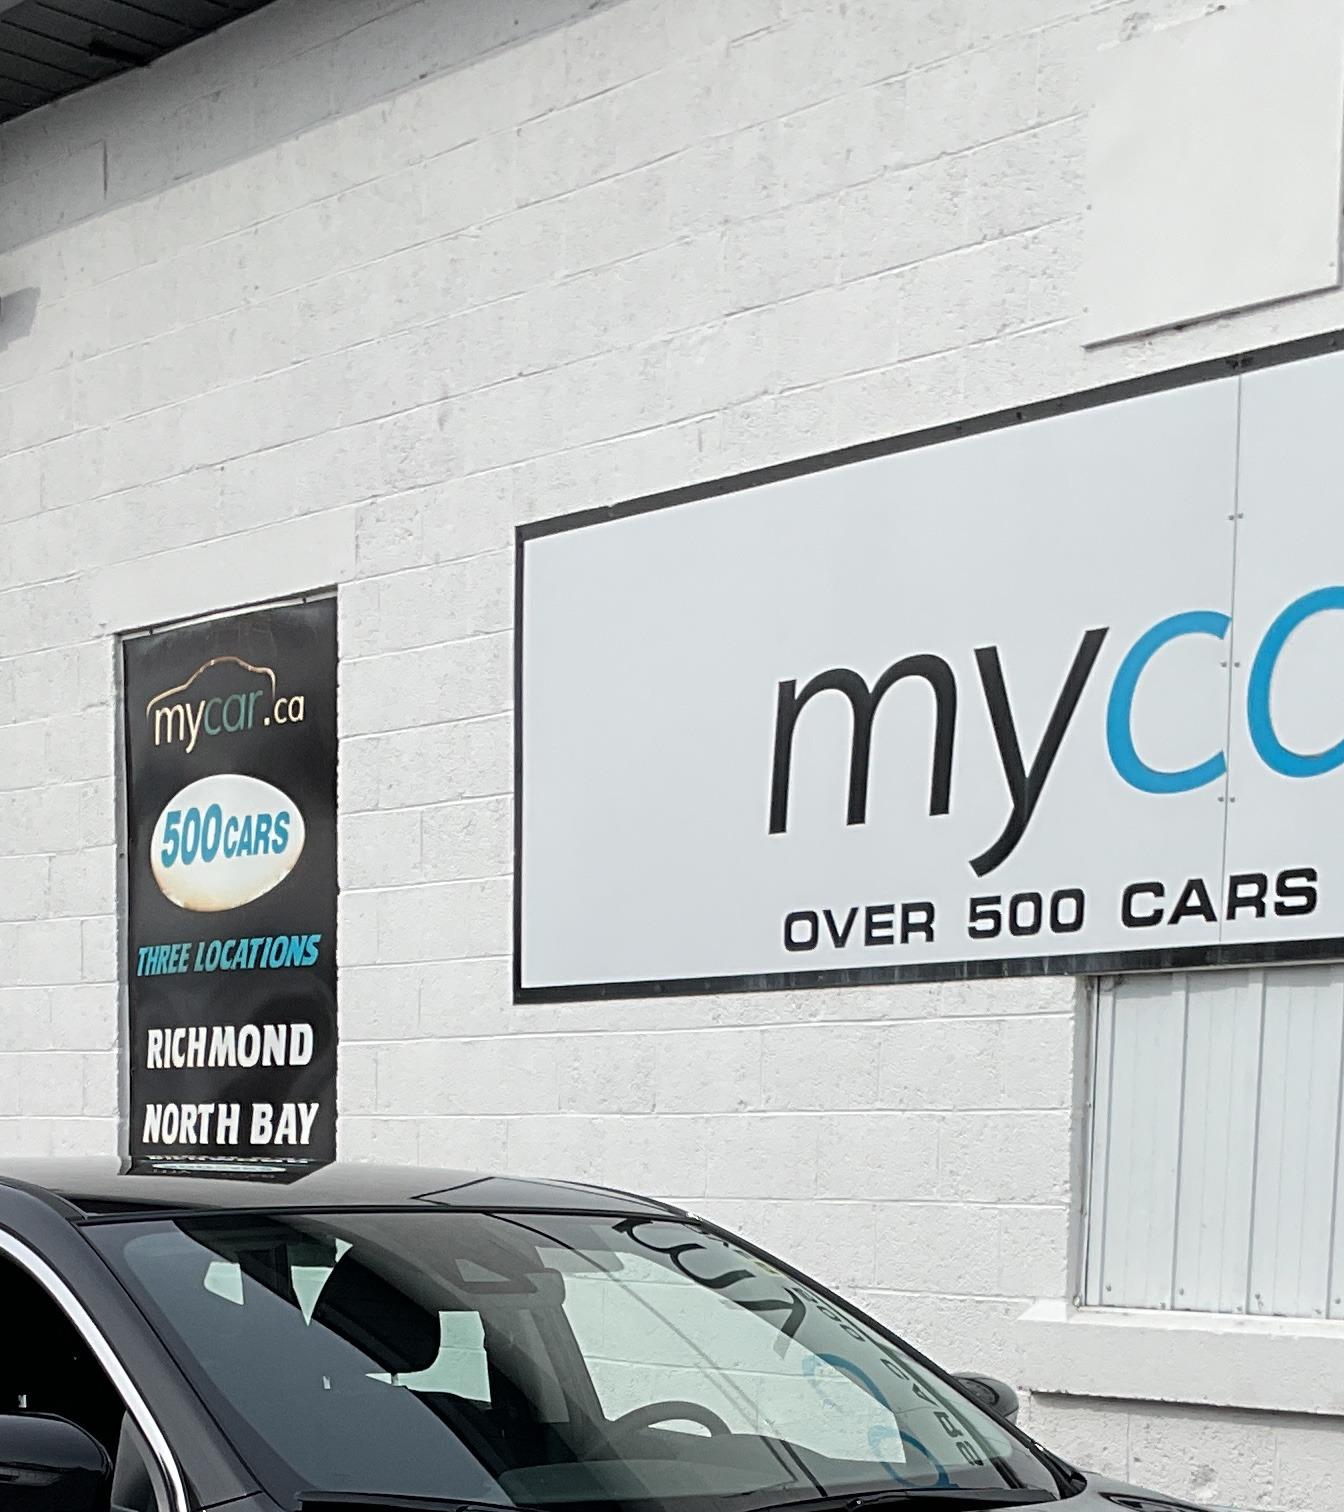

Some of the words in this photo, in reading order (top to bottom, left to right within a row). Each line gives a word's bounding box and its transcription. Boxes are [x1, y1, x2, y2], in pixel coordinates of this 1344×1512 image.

[784, 901, 935, 952] OVER
[968, 888, 1085, 940] 500
[1121, 867, 1318, 929] CARS
[136, 940, 189, 977] THREE
[193, 933, 322, 972] LOCATIONS
[146, 1023, 314, 1069] RICHMOND
[142, 1102, 241, 1146] NORTH
[249, 1102, 320, 1146] BAY
